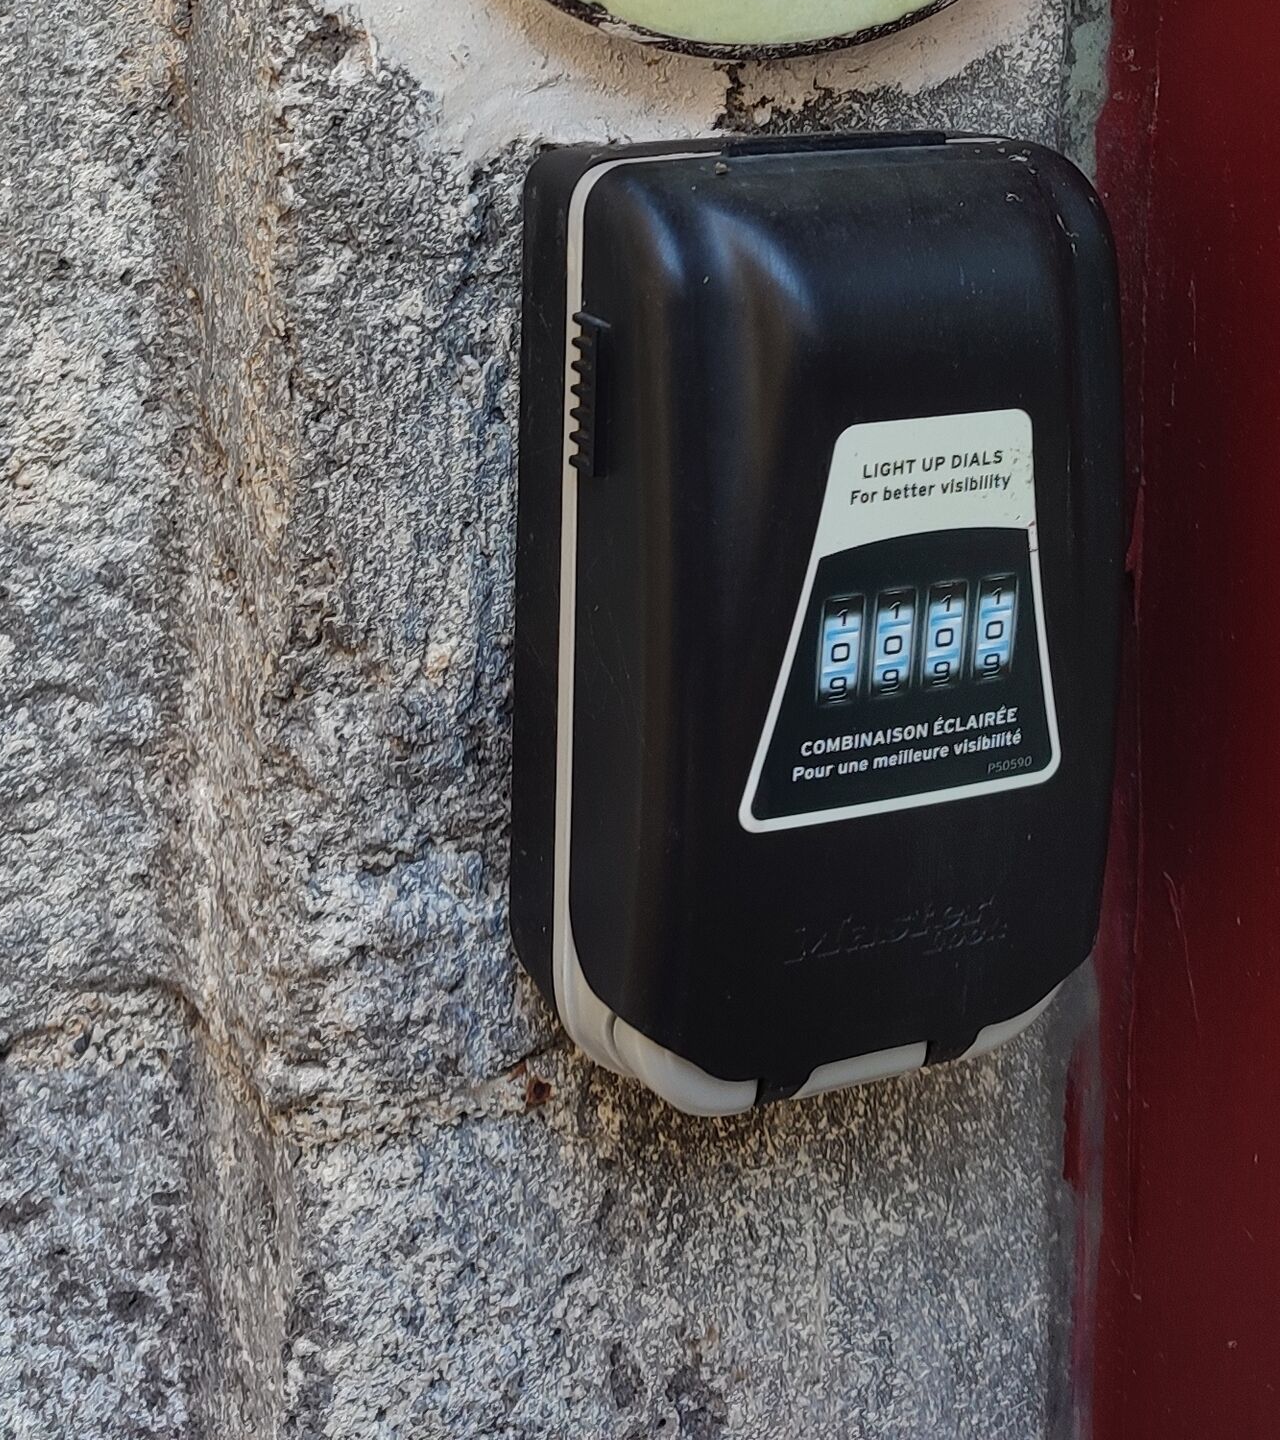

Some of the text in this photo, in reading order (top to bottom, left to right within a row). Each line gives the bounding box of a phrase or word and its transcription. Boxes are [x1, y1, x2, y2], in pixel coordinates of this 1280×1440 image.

[862, 449, 1004, 480] LIGHT UP DIALS
[849, 471, 1012, 506] For better visibility
[800, 705, 1018, 758] COMBINAISON ÉCLAIRÉE
[792, 727, 1022, 782] Pour une meilleure visibilité
[986, 754, 1033, 775] P50590
